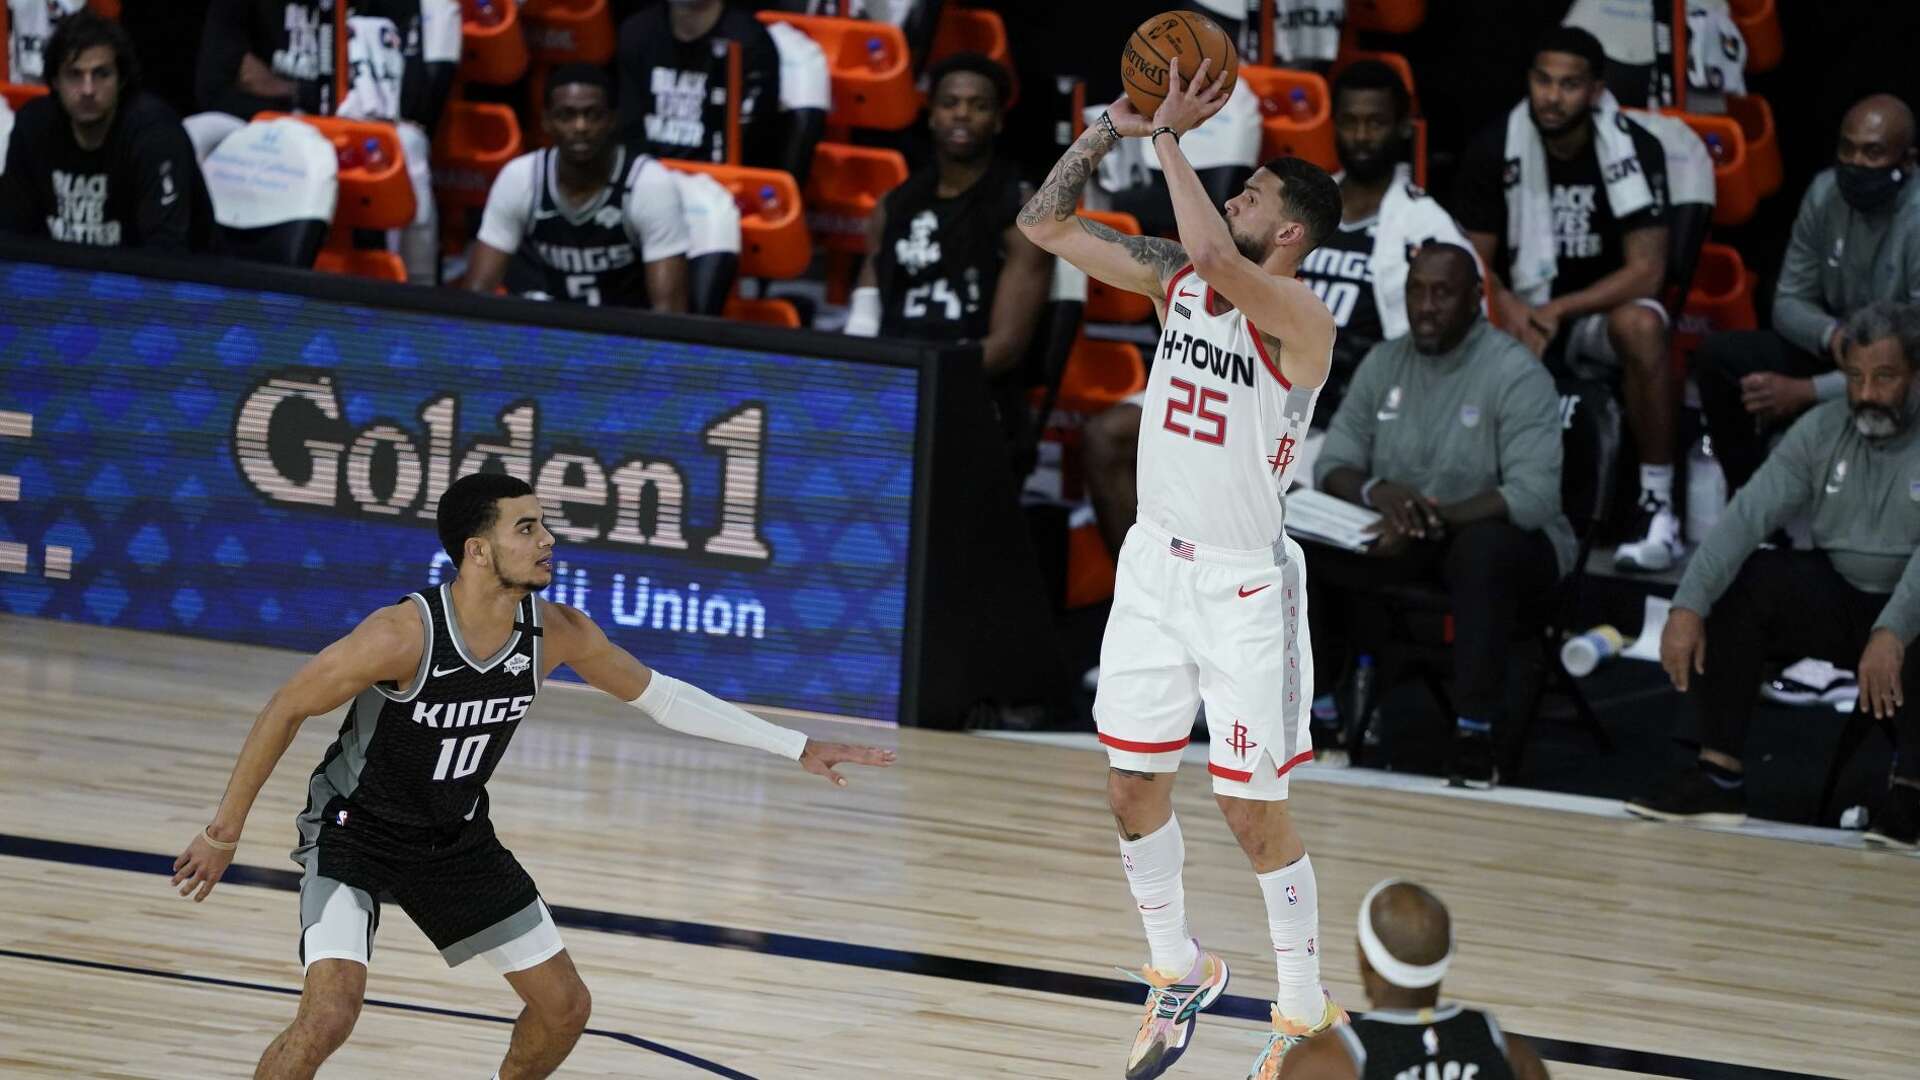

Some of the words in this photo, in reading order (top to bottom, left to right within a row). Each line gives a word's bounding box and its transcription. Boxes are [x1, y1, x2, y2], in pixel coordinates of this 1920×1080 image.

[1298, 246, 1375, 282] ING
[1161, 328, 1255, 388] H-TOWN
[1162, 375, 1229, 447] 25
[234, 375, 690, 551] Golden
[703, 405, 772, 560] 1
[611, 573, 766, 639] Union
[411, 694, 534, 729] KINGS
[431, 733, 491, 781] 10
